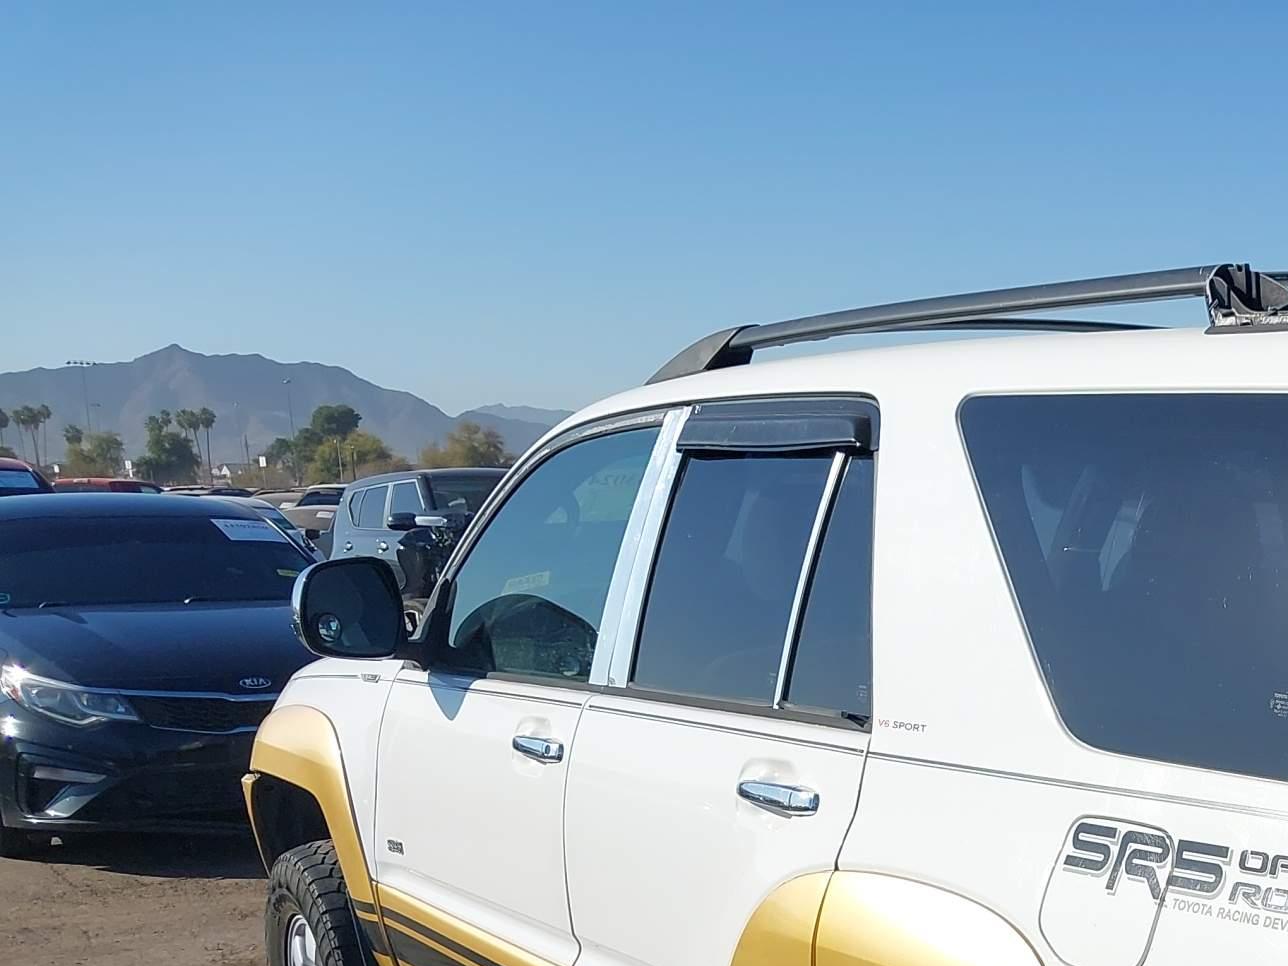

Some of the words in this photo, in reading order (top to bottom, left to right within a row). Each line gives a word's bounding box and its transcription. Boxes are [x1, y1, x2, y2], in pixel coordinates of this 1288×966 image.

[892, 720, 928, 732] SPORT
[1062, 822, 1233, 900] SR5
[1172, 898, 1213, 917] TOYOTA
[1216, 907, 1261, 927] RACING
